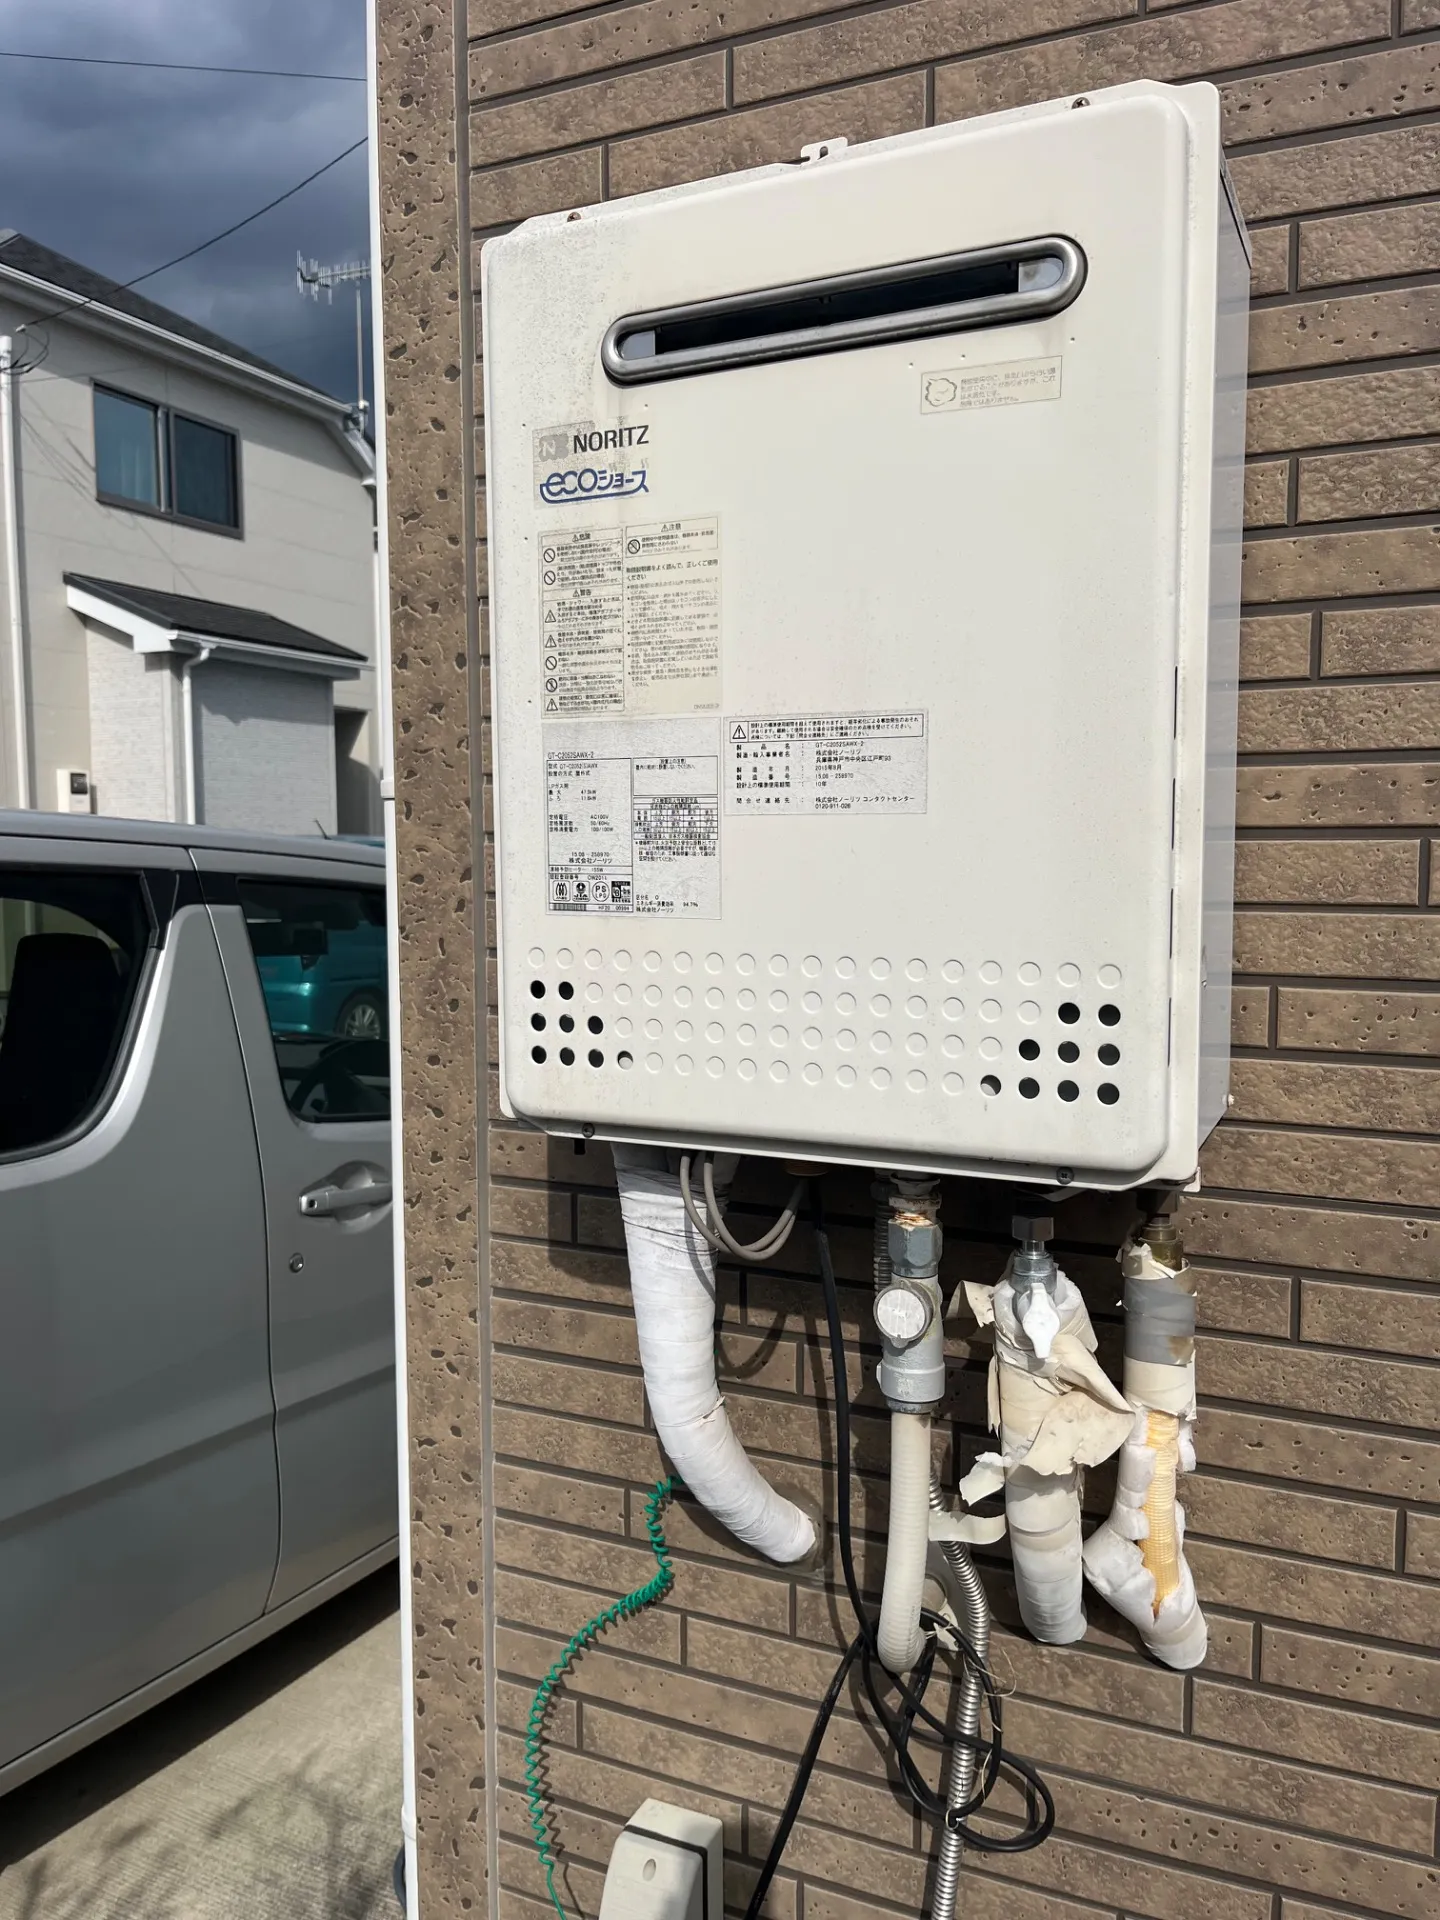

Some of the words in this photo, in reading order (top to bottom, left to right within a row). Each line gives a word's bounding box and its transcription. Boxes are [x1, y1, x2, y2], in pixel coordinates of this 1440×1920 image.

[573, 425, 649, 454] NORITZ
[669, 523, 681, 531] 注意
[815, 755, 891, 764] 兵庫県神戸市中央区江戸町93
[737, 781, 791, 789] 設計上の標準使用期間
[863, 795, 915, 803] コンタクトセンター
